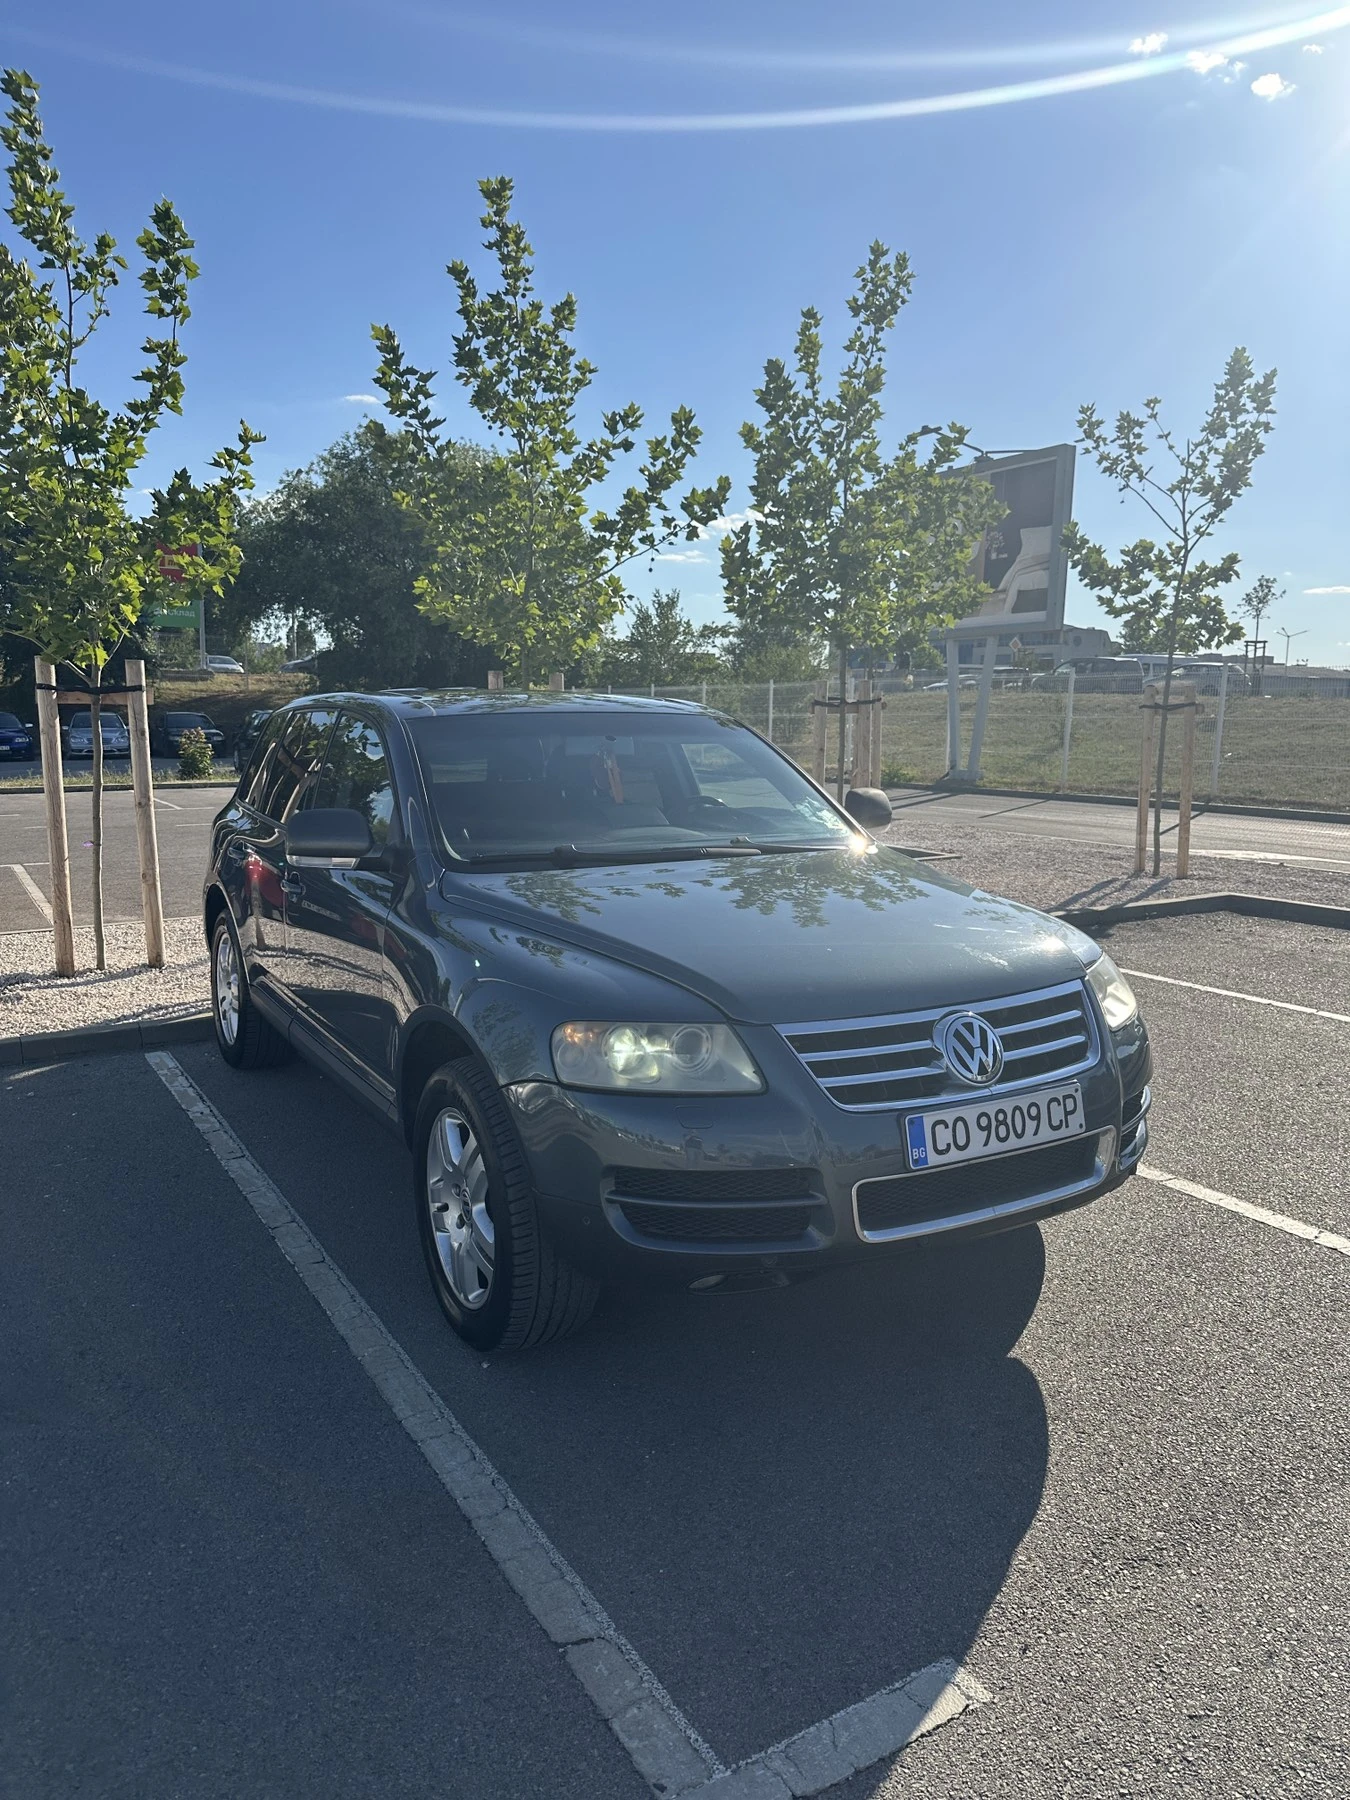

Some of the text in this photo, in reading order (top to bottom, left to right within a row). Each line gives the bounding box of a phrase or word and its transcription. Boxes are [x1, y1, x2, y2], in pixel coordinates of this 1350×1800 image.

[930, 1093, 1078, 1156] CO 9809 CP
[912, 1147, 926, 1160] BG
